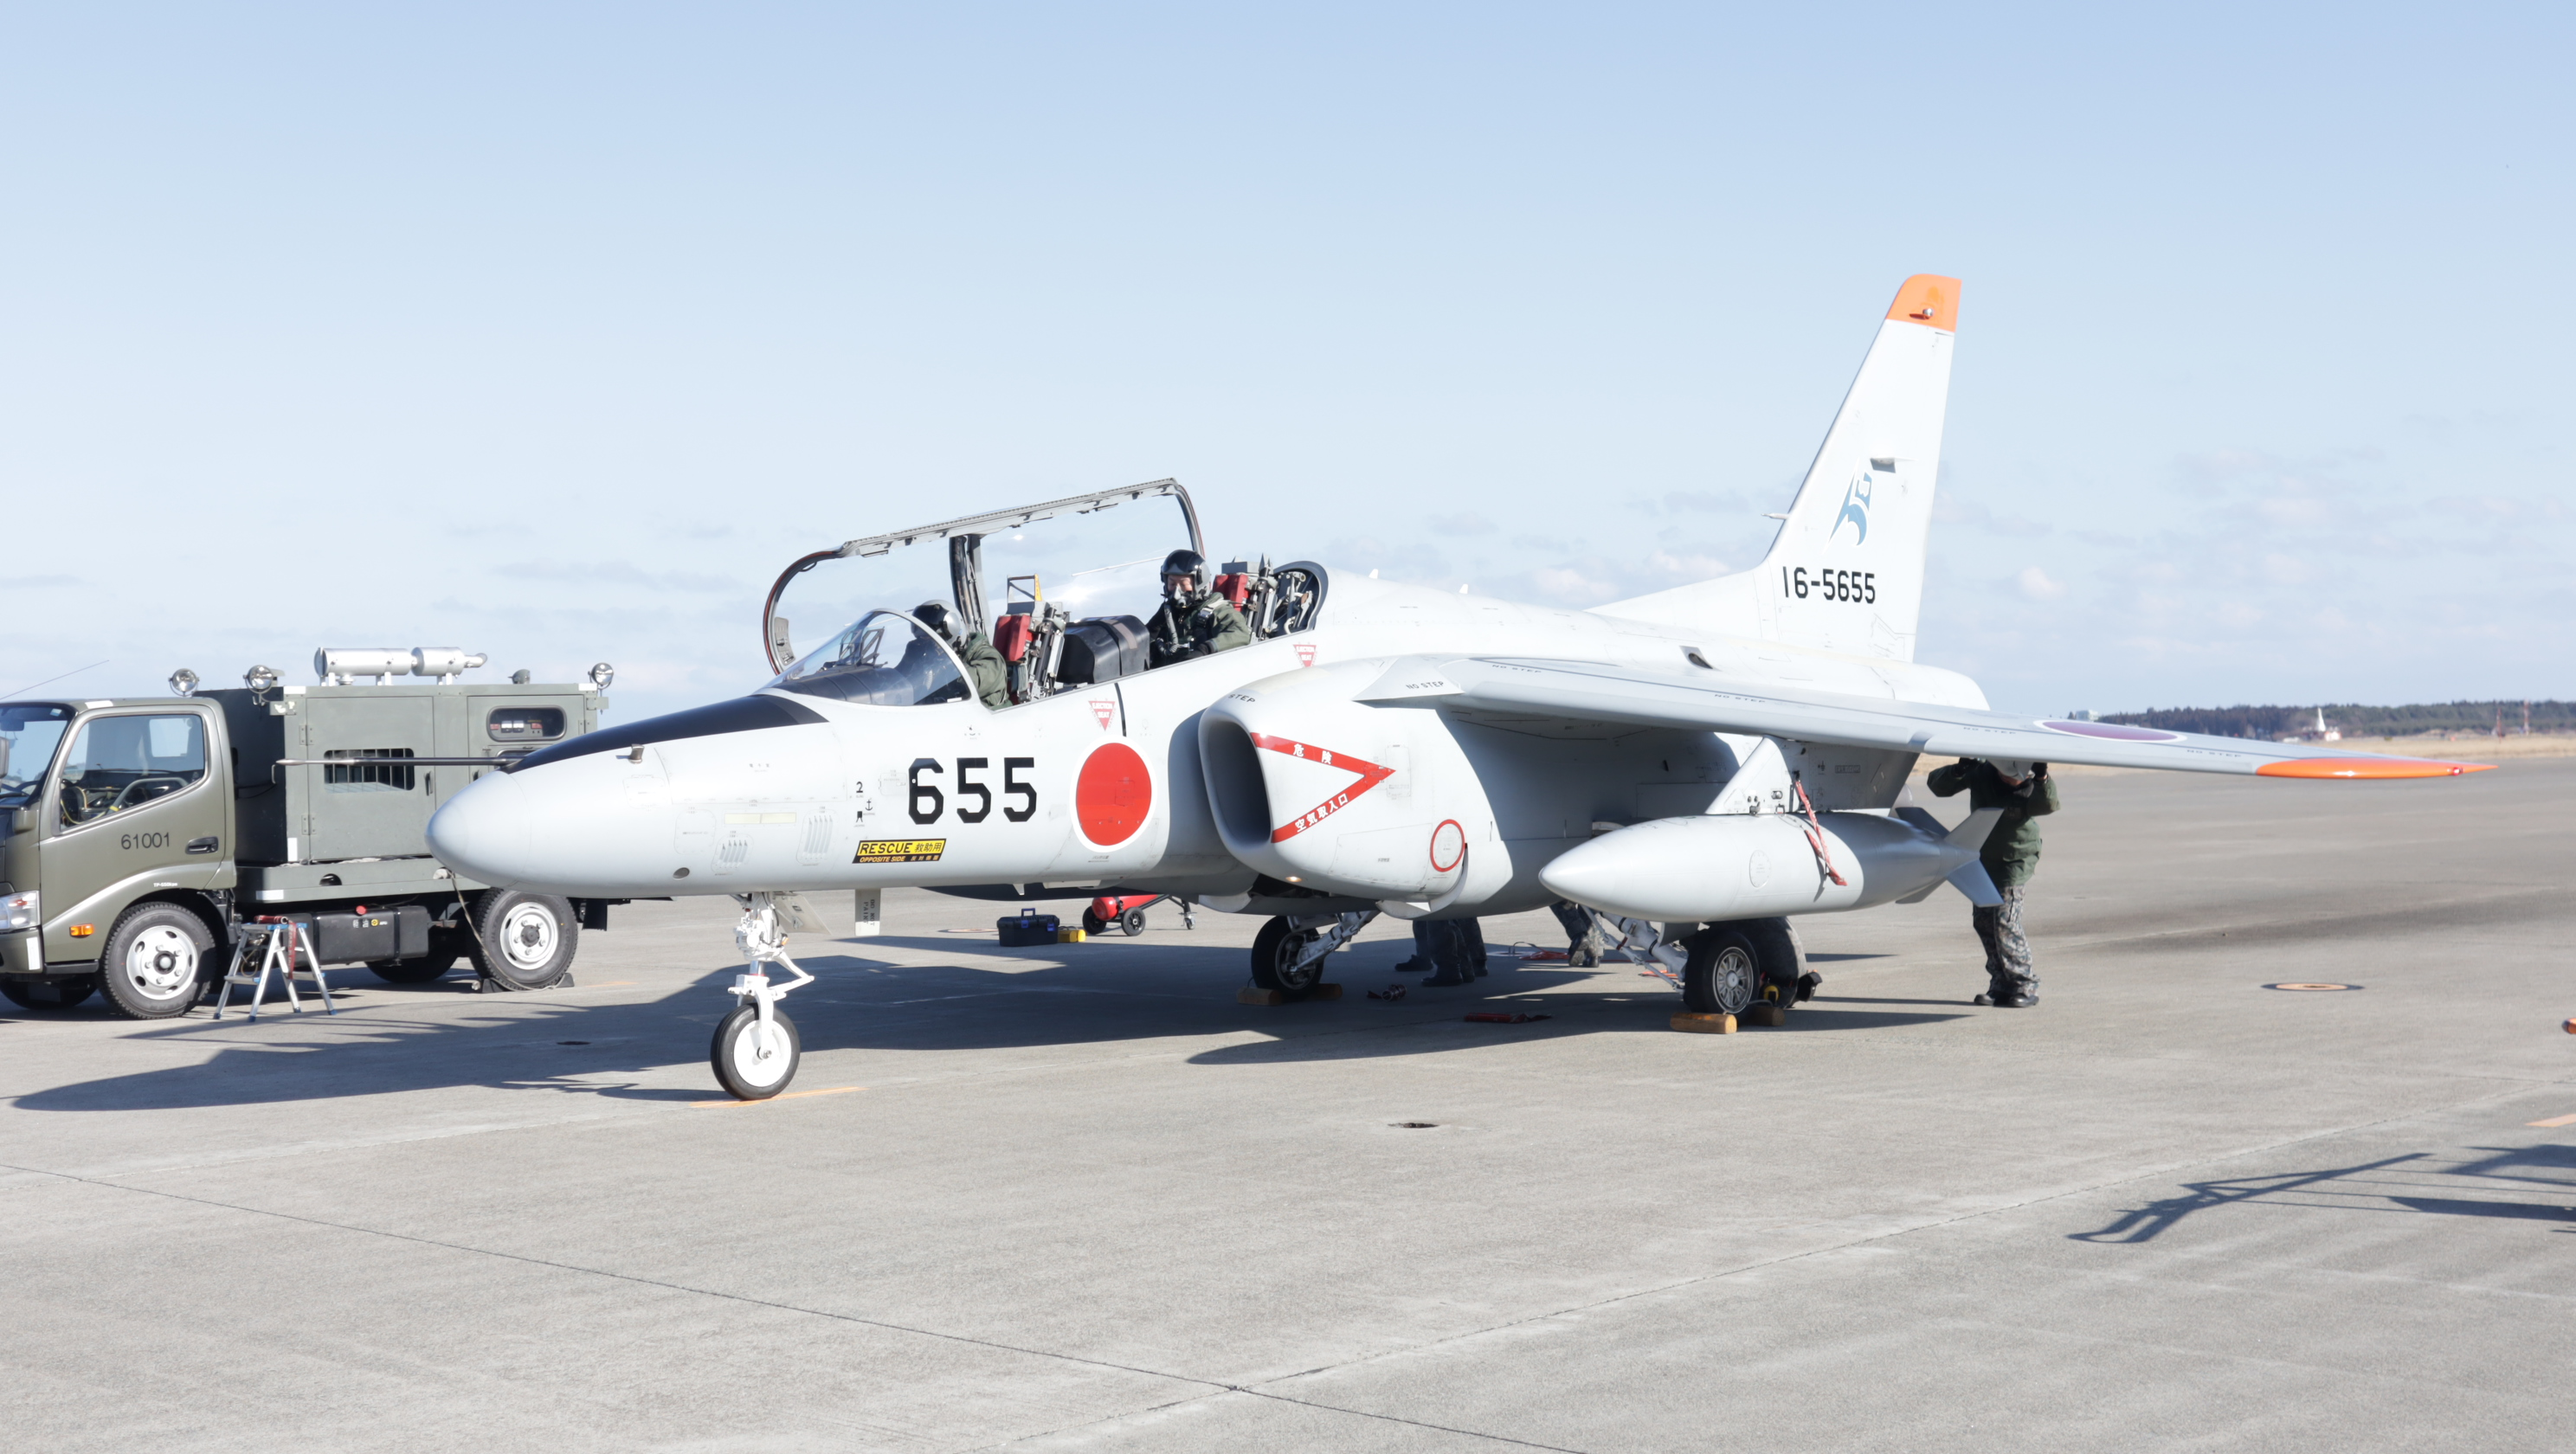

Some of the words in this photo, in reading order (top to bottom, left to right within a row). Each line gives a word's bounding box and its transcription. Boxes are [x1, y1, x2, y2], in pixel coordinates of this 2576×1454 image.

[1782, 566, 1876, 604] 16-5655
[1228, 693, 1255, 702] STEP
[1292, 743, 1333, 765] 危険
[908, 756, 1038, 825] 655
[1295, 793, 1349, 833] 空気取入口
[121, 832, 170, 850] 61001
[860, 842, 913, 854] RESCUE
[914, 842, 943, 852] 救助用
[870, 899, 875, 909] DO
